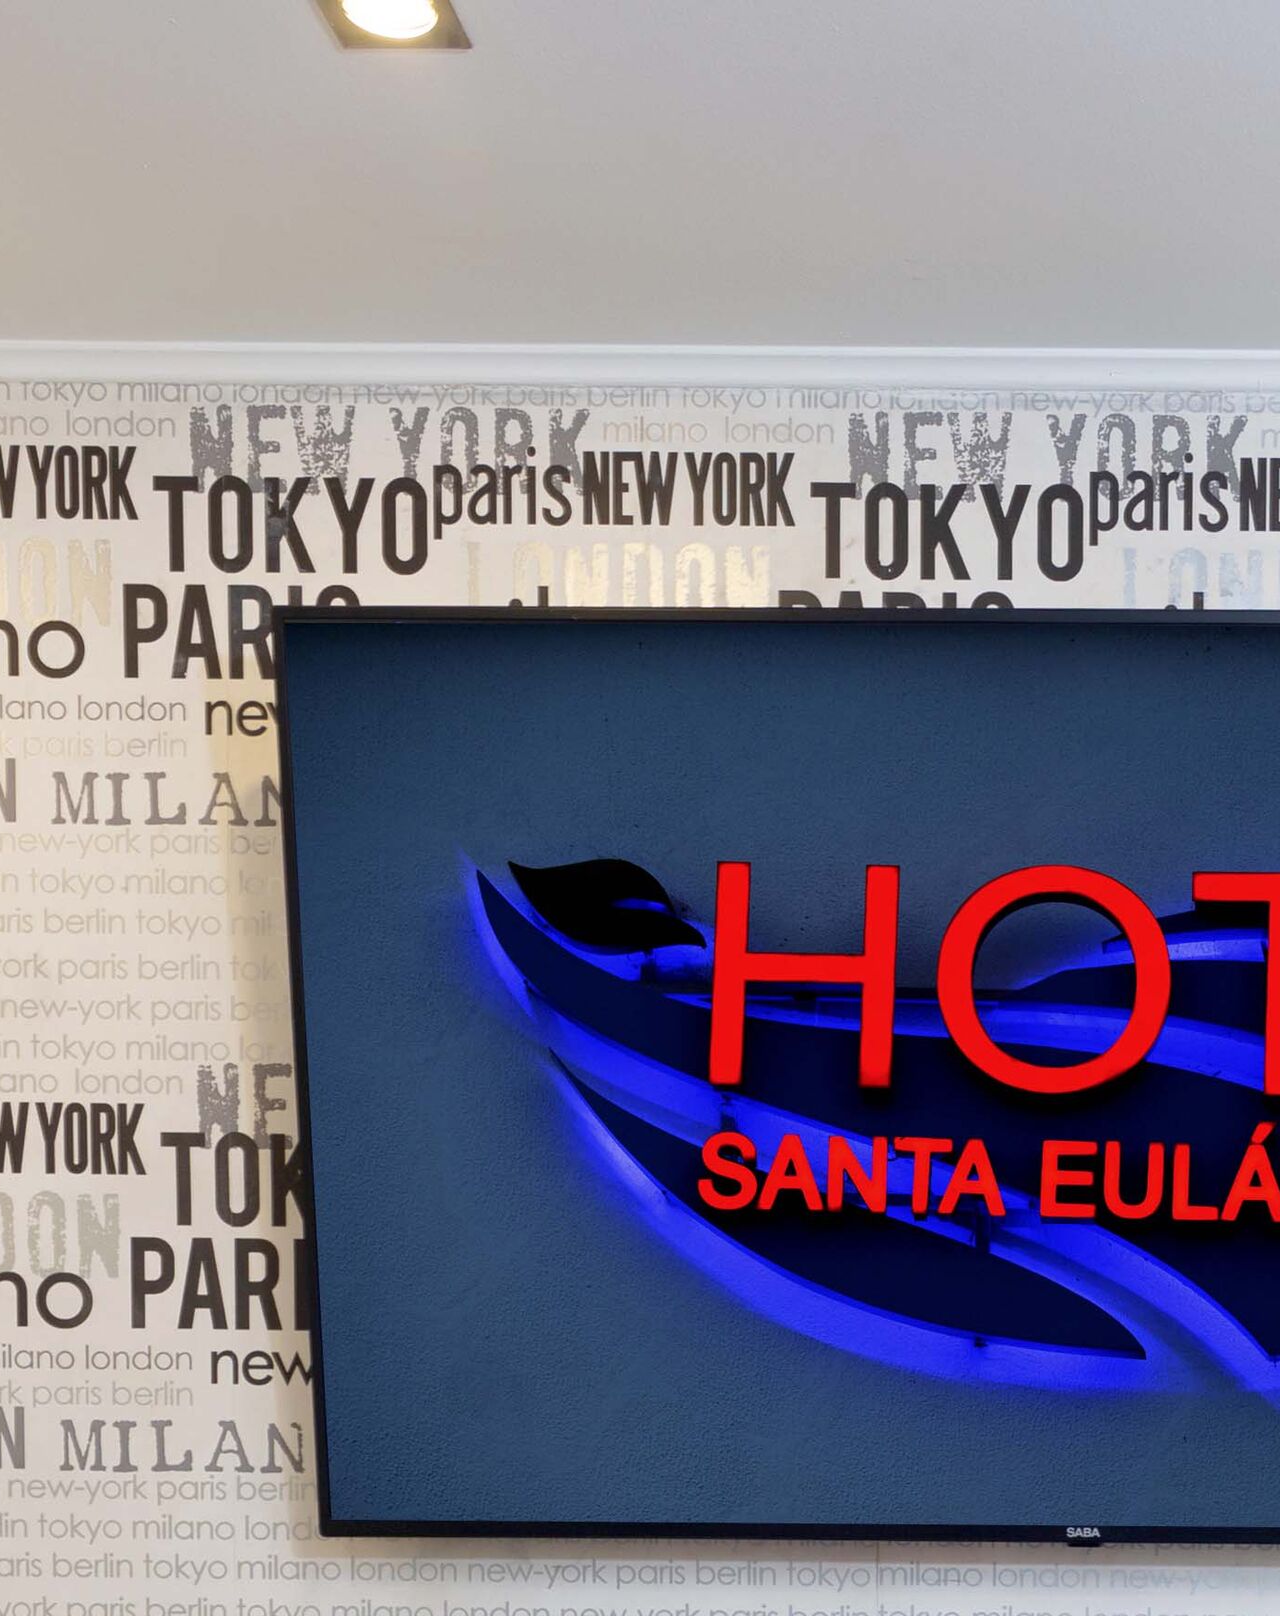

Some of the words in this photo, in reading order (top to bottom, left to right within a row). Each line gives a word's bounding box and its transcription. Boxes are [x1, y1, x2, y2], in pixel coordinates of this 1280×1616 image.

[66, 410, 176, 436] london
[603, 417, 707, 443] milano
[724, 416, 834, 444] london
[27, 446, 137, 519] YORK
[434, 447, 572, 540] paris
[583, 451, 678, 526] NEW
[685, 452, 795, 527] YORK
[1089, 453, 1228, 546] paris
[153, 475, 428, 575] TOKYO
[810, 482, 1084, 581] TOKYO
[78, 696, 186, 721] london
[29, 867, 114, 899] tokyo
[75, 1069, 183, 1096] london
[36, 1102, 146, 1175] YORK
[697, 1131, 1007, 1217] SANTA
[85, 1345, 193, 1370] london
[1066, 1527, 1101, 1538] SABA
[351, 1556, 456, 1584] london
[467, 1556, 607, 1590] new-york
[616, 1561, 685, 1589] paris
[695, 1558, 777, 1586] berlin
[787, 1560, 870, 1593] tokyo
